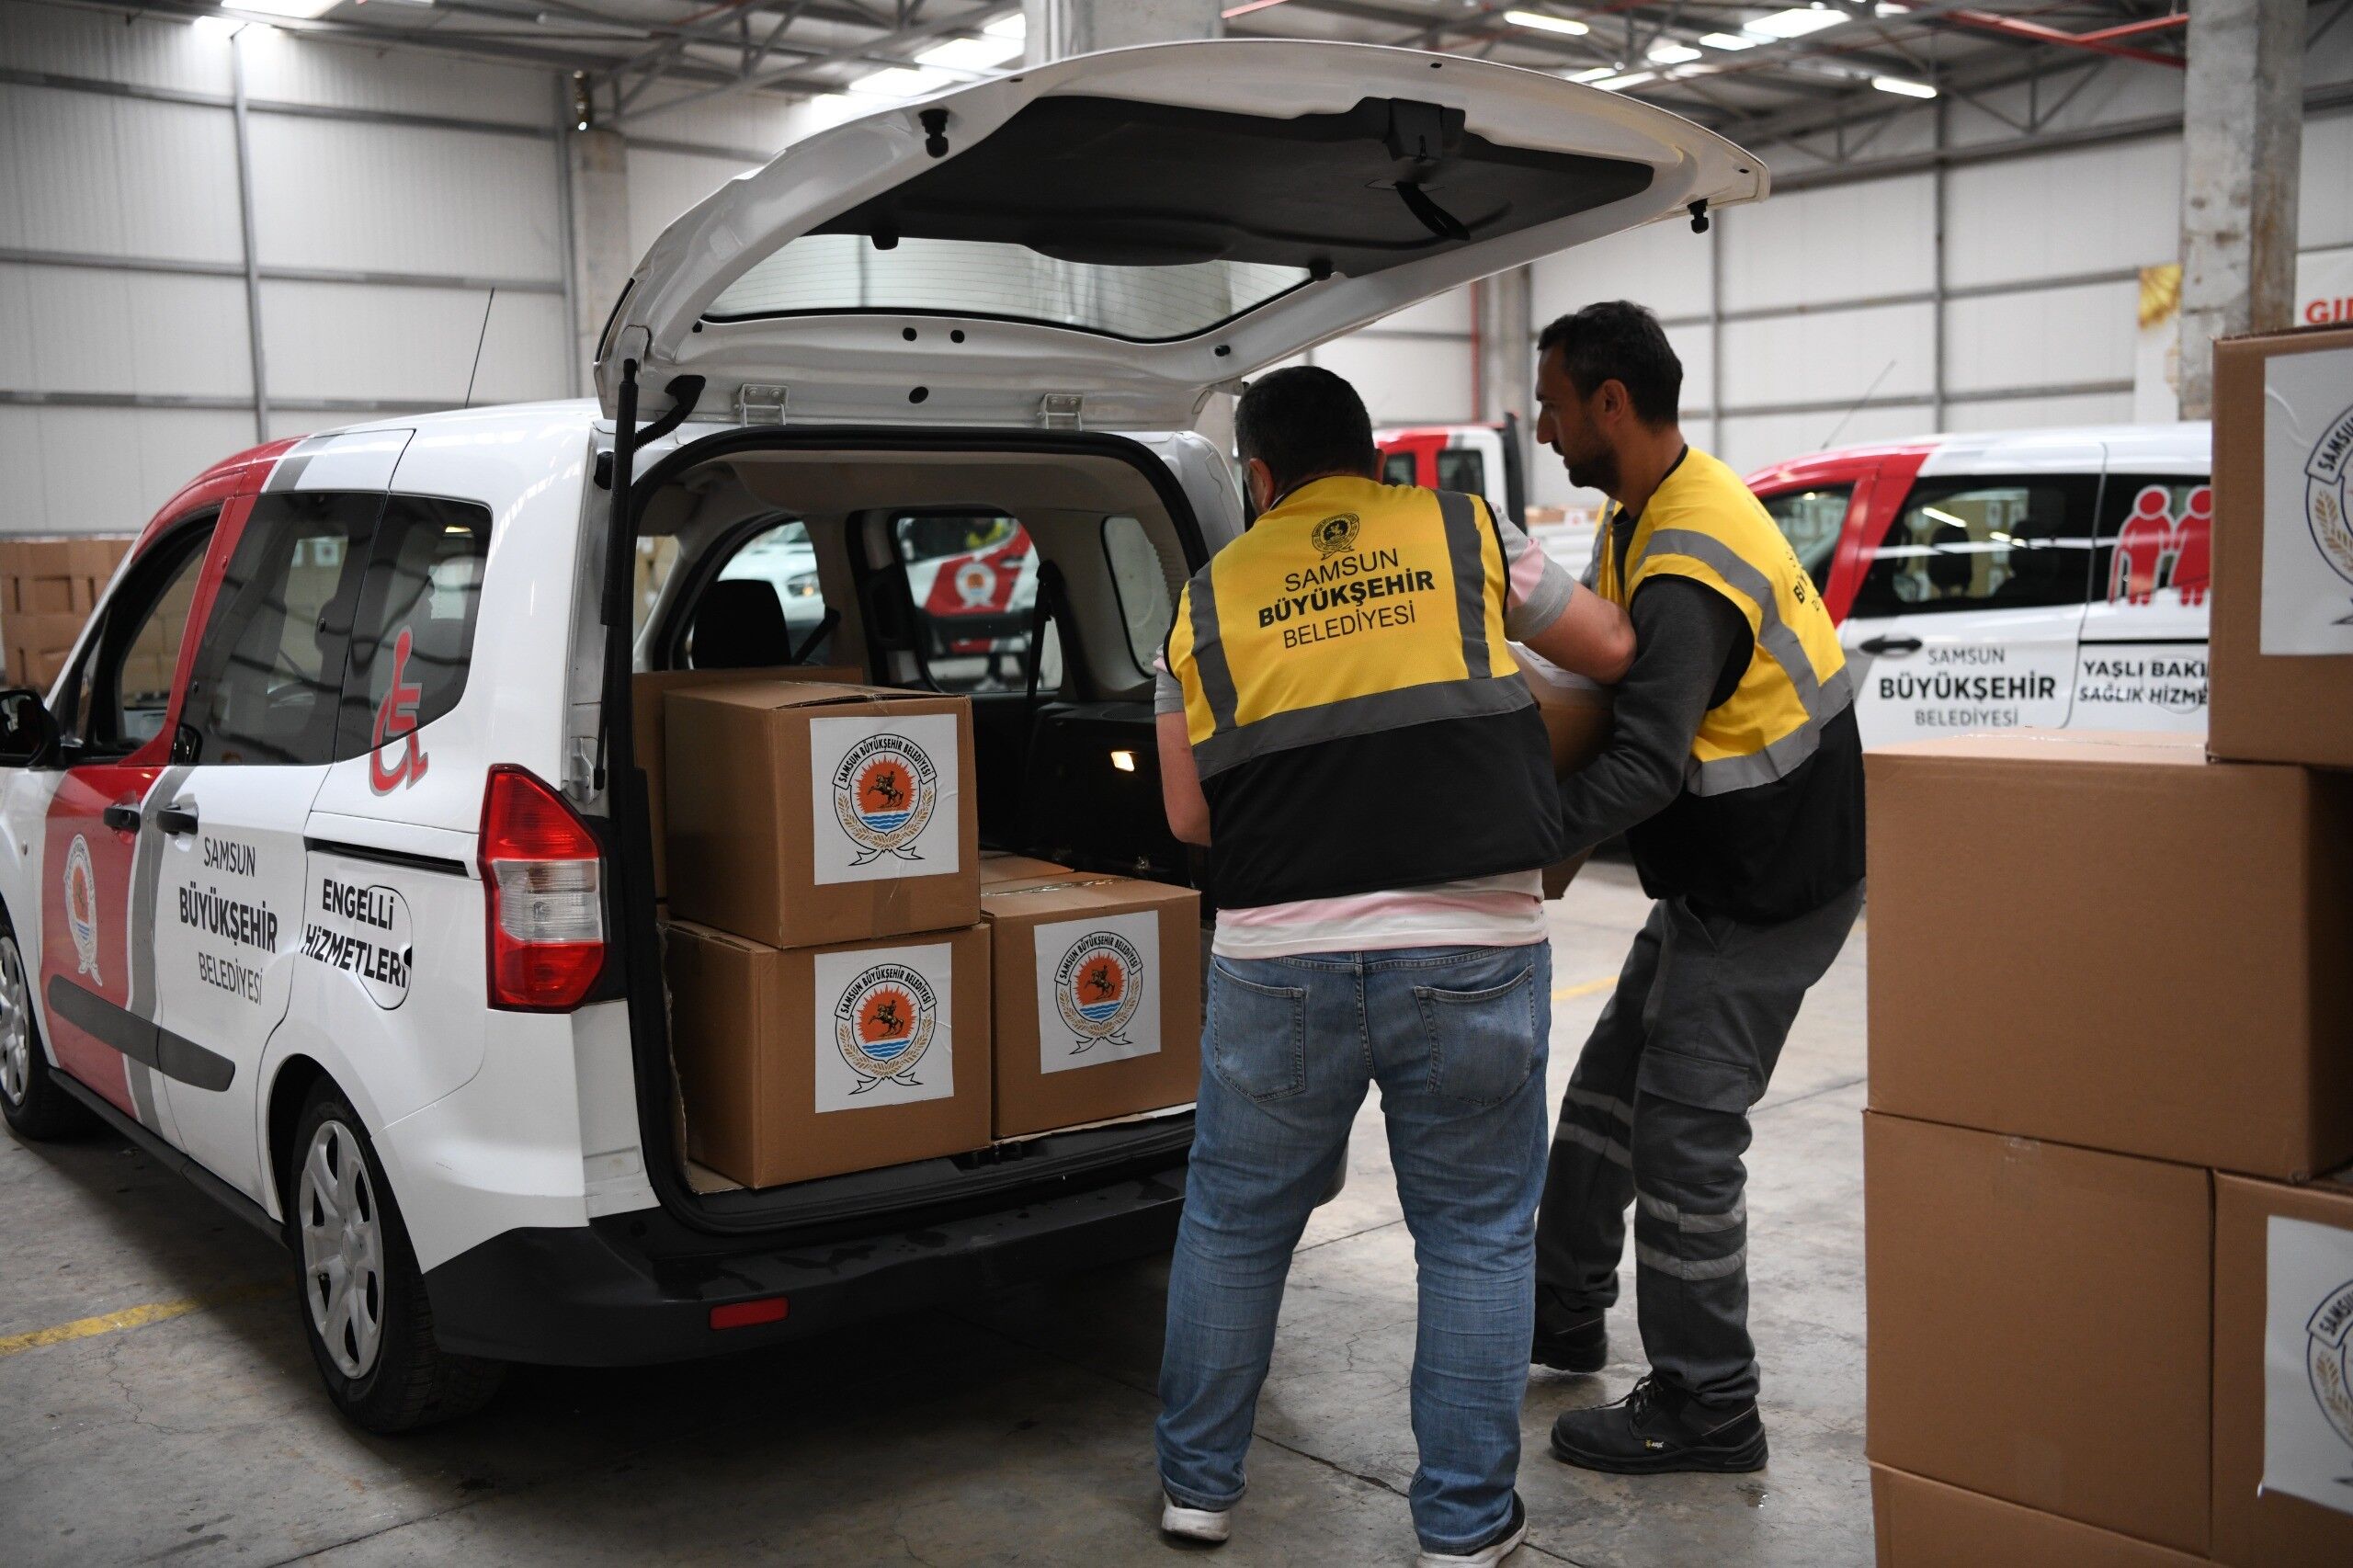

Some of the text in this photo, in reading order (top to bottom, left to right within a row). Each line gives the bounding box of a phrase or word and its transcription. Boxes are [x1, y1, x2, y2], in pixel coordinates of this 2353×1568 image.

[2317, 415, 2353, 472] SAMSU
[1285, 548, 1399, 592] SAMSUN
[1258, 568, 1436, 628] BÜYÜKŞEHİR
[1283, 599, 1415, 649] BELEDİYESİ
[1927, 647, 2006, 665] SAMSUN
[2084, 661, 2209, 677] YAŞLI BAKI
[1879, 670, 2056, 703] BÜYÜKŞEHİR
[2079, 682, 2143, 702] SAĞLIK
[1915, 707, 2018, 727] BELEDİYESİ
[838, 736, 932, 782] SAMSUN BÜYÜKŞEHİR BELEDİYESİ
[204, 836, 256, 877] SAMSUN
[179, 881, 278, 954] BÜYÜKŞEHİR
[199, 952, 263, 1006] BELEDİYESİ
[1060, 933, 1139, 979] SAMSUN BÜYÜKŞEHİR BELEDİYESİ
[840, 965, 935, 1013] SAMSUN BÜYÜKŞEHİR BELEDİYESİ
[2319, 1290, 2353, 1336] SAMSU
